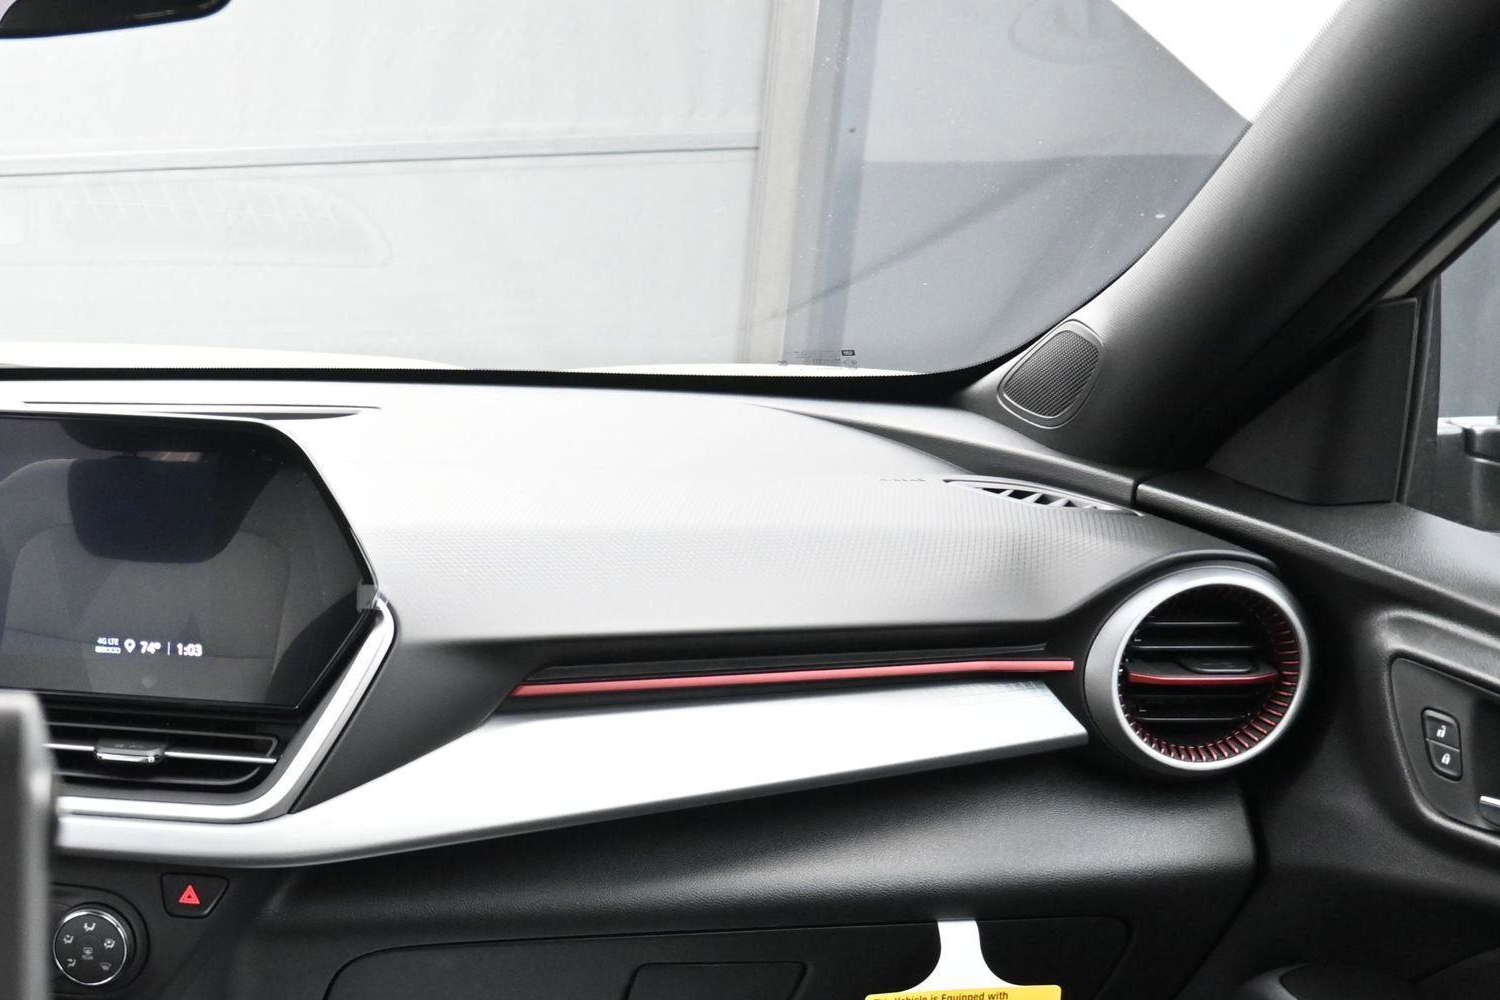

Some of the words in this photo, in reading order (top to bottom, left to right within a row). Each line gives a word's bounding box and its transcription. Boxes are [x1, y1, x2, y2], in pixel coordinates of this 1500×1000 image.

[107, 638, 120, 646] LTE
[176, 642, 202, 657] 1:03
[988, 991, 1009, 1000] with
